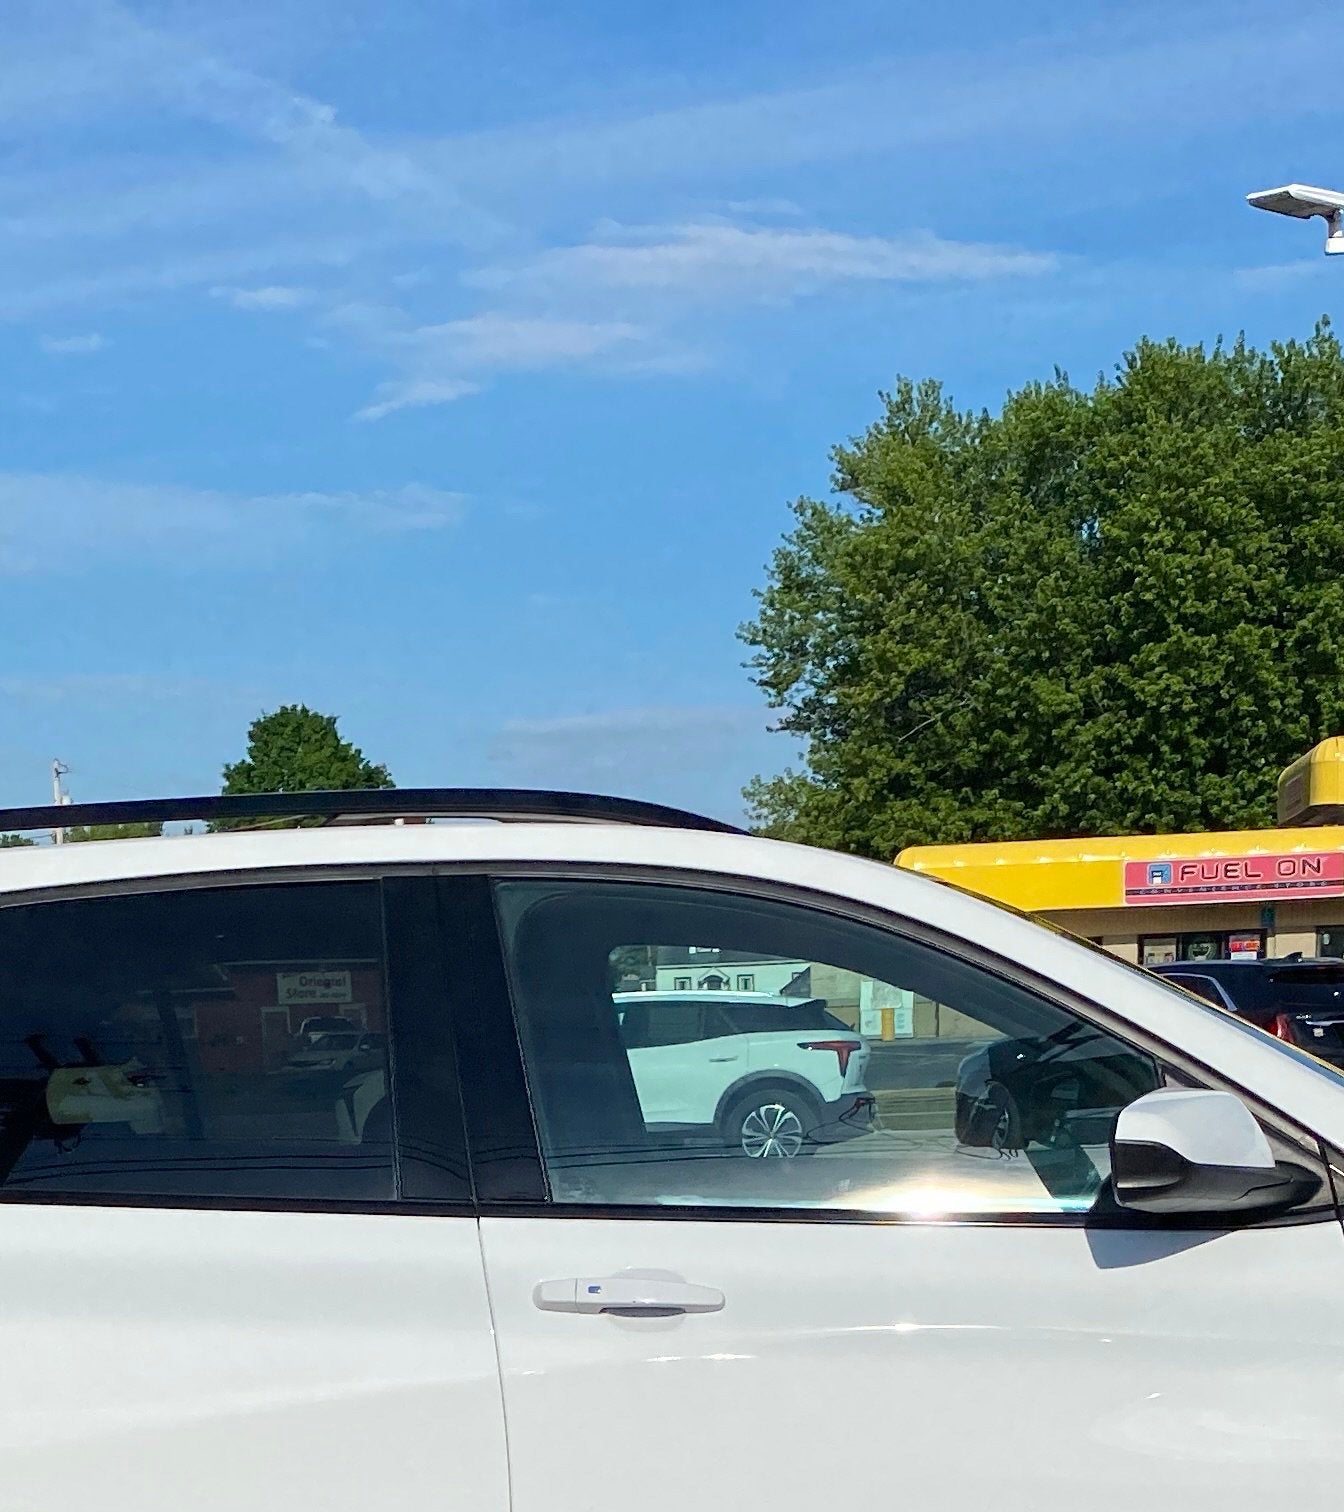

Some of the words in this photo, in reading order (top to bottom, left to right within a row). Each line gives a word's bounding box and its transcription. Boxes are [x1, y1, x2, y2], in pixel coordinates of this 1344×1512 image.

[1180, 861, 1262, 881] FUEL
[1277, 857, 1321, 876] ON
[1138, 884, 1263, 895] CONVENIENCE
[1273, 879, 1329, 890] STORE
